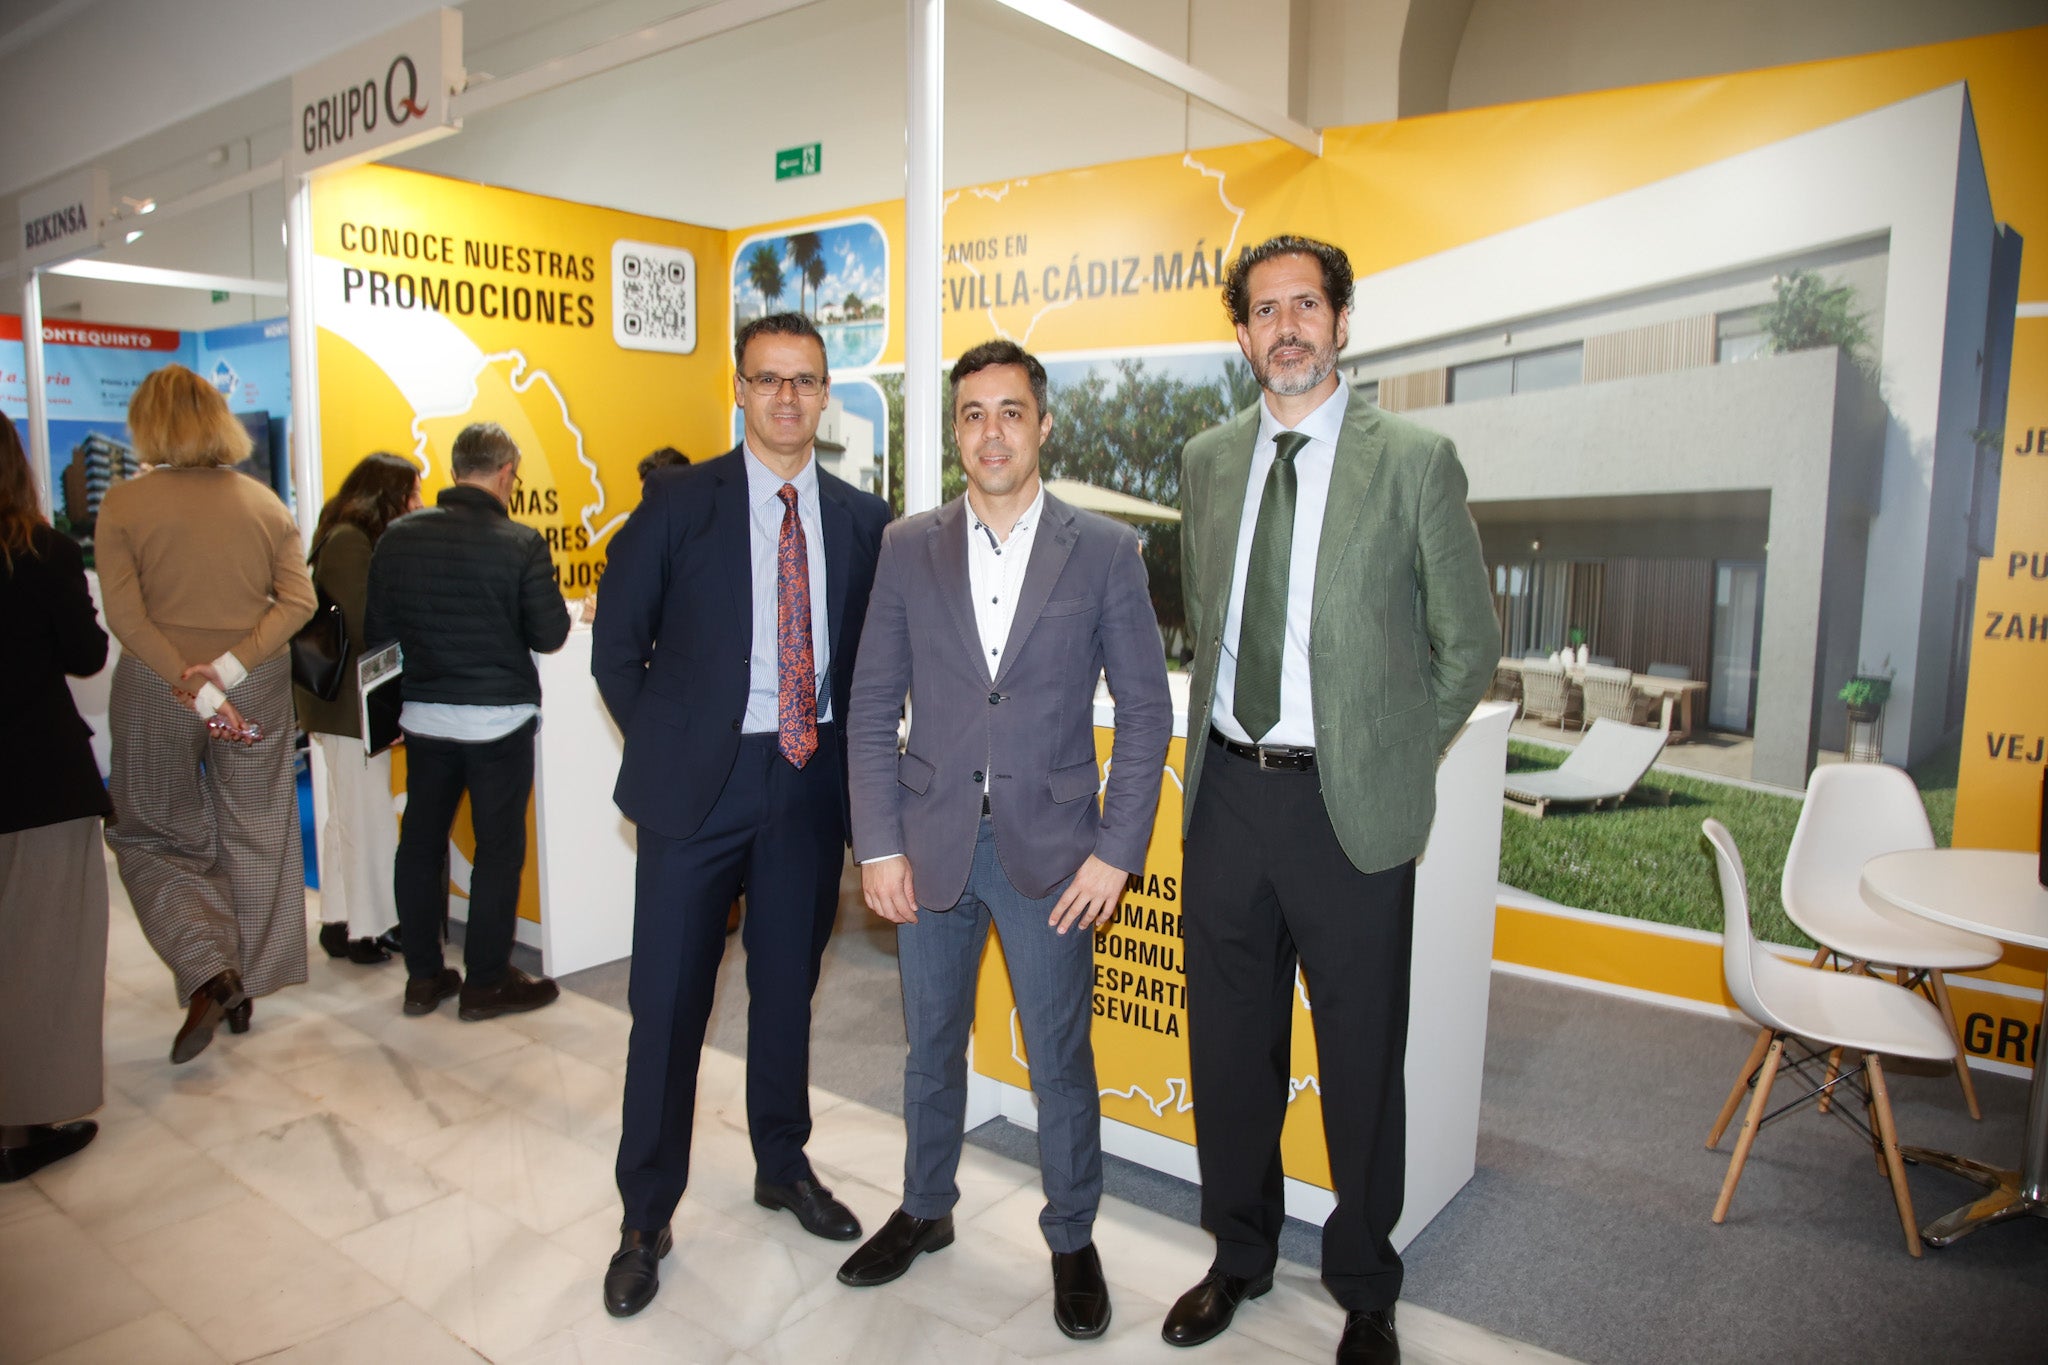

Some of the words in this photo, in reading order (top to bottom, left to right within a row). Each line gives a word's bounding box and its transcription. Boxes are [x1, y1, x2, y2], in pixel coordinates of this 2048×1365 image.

[303, 79, 378, 155] GRUPO
[384, 54, 429, 126] Q
[25, 203, 87, 249] BEKINSA
[942, 238, 998, 264] AMOS
[1004, 234, 1027, 257] EN
[340, 221, 454, 265] CONOCE
[464, 239, 595, 283] NUESTRAS
[343, 266, 595, 328] PROMOCIONES
[942, 240, 1254, 312] VILLA-CÁDIZ-MÁL
[553, 561, 606, 588] JOS
[1987, 731, 2044, 763] VEJ
[1094, 963, 1185, 1009] ESPARTI
[1093, 993, 1179, 1038] SEVILLA
